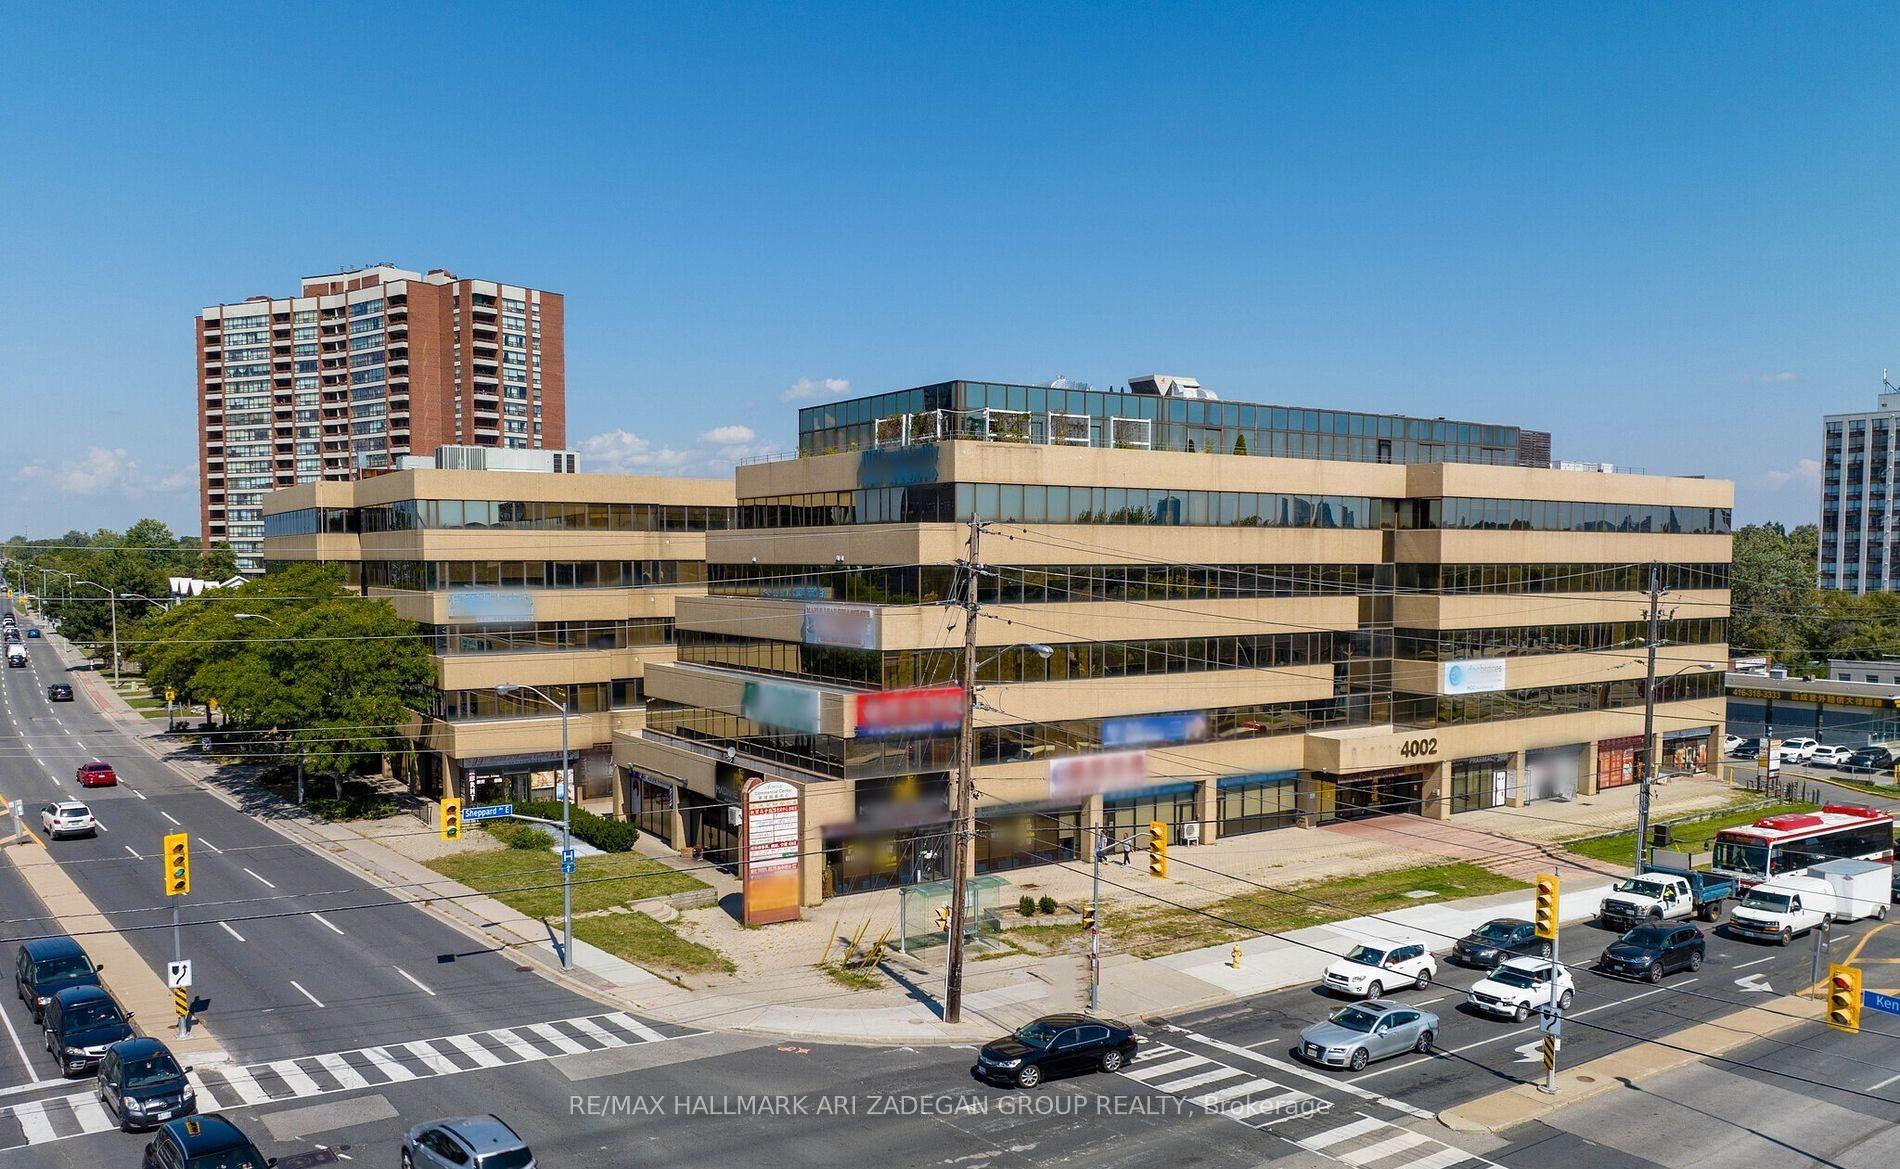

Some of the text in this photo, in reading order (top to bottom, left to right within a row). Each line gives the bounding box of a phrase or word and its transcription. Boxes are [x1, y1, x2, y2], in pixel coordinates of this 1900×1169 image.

[1401, 738, 1438, 758] 4002
[465, 808, 497, 818] Sheppard
[564, 851, 573, 862] H
[1877, 996, 1899, 1011] Ken
